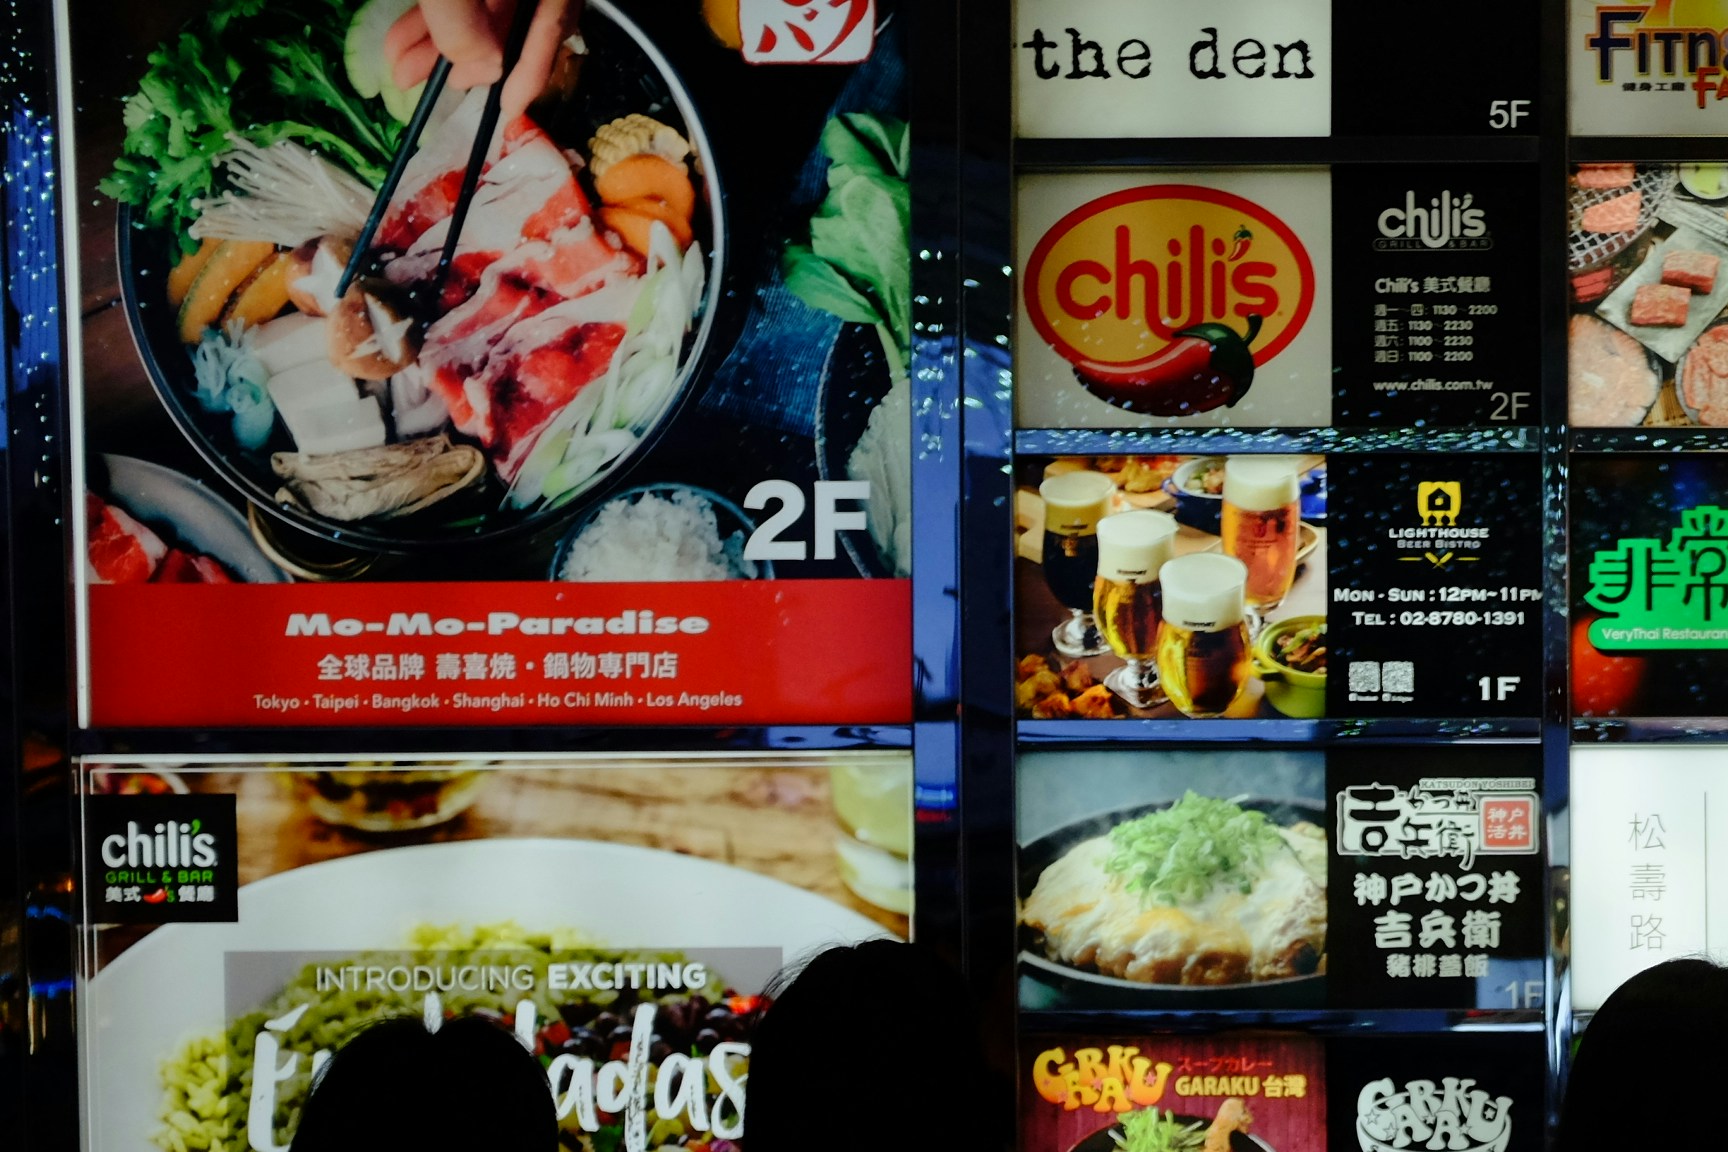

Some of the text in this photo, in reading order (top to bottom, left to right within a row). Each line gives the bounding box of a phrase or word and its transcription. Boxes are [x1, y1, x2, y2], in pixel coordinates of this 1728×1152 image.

[1023, 28, 1315, 81] the den
[1488, 100, 1532, 129] 5F
[1377, 190, 1487, 249] chili's
[1055, 224, 1280, 343] chili's
[1374, 276, 1491, 293] Chili's 美式餐廳
[1489, 392, 1531, 420] 2F
[742, 480, 871, 561] 2F
[1388, 528, 1490, 539] LIGHTHOUSE
[285, 610, 710, 636] Mo-Mo-Paradise
[1399, 611, 1525, 626] 02-8780-1391
[1601, 628, 1661, 642] VeryThai
[317, 653, 425, 680] 全球品牌
[253, 691, 743, 711] Tokyo Taipei Bangkok Shanghai Ho Chi Minh Los Angeles
[1478, 676, 1521, 701] 1F
[1420, 780, 1535, 789] KATSUDON YOSHIBEI
[101, 819, 217, 868] chili's
[105, 870, 213, 883] GRILL & BAR
[1627, 812, 1668, 952] 松壽路
[1373, 909, 1502, 949] 吉兵衛
[315, 962, 707, 992] INTRODUCING EXCITING
[1504, 980, 1545, 1010] 1F
[1177, 1055, 1273, 1073] スープカレー
[1174, 1073, 1308, 1098] GARAKU 台灣
